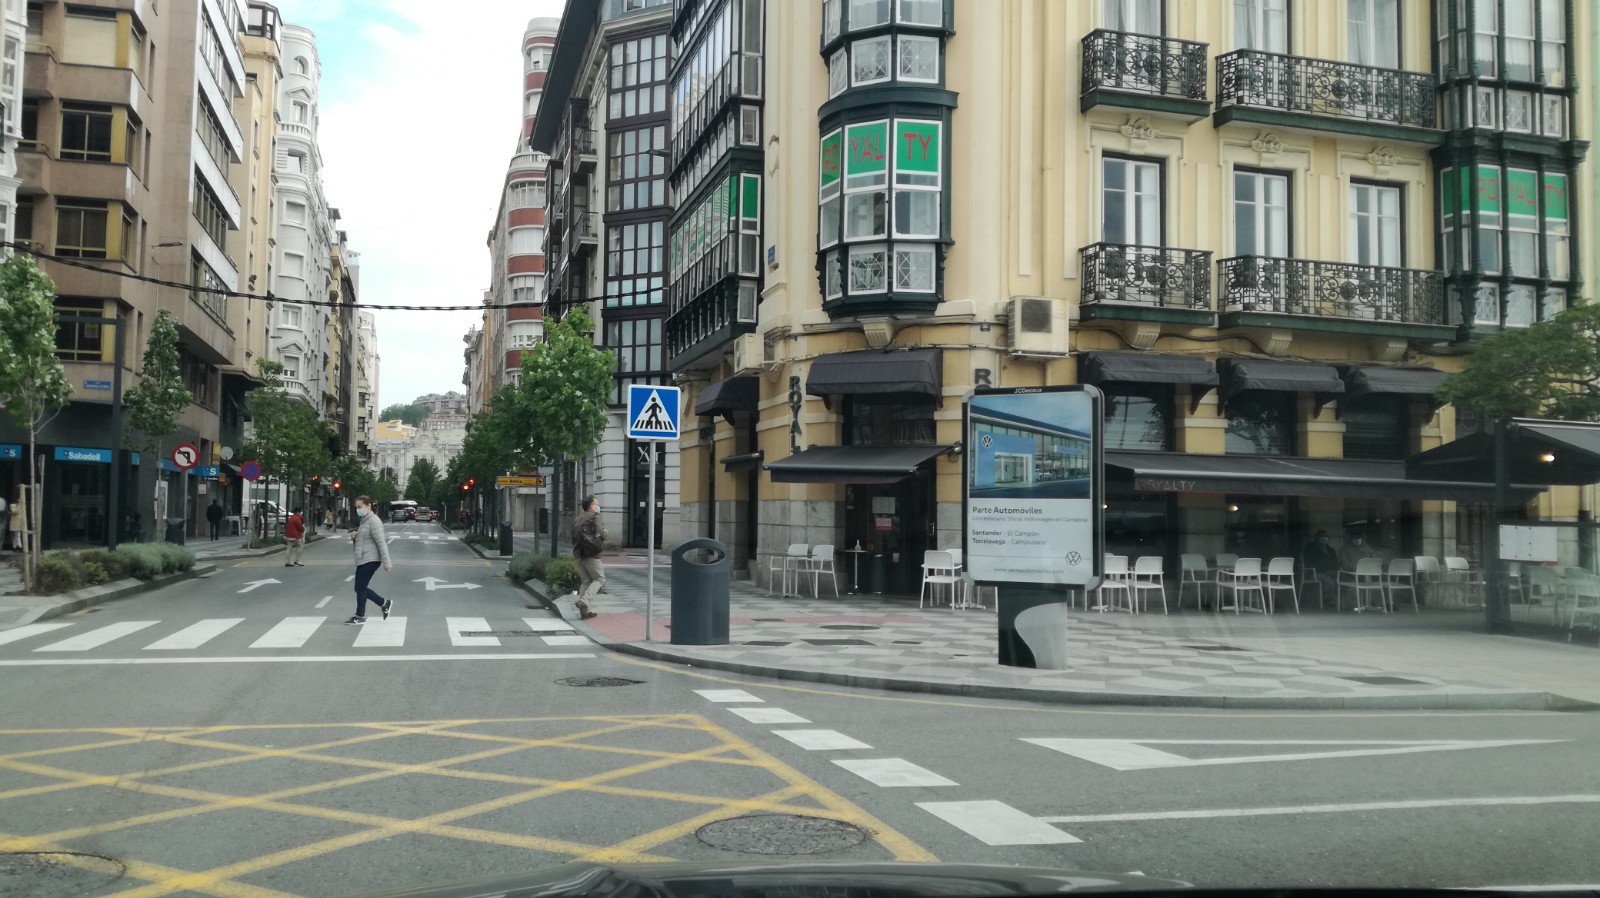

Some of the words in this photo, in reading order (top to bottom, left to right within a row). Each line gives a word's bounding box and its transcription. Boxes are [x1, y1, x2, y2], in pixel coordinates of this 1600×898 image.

[68, 451, 101, 461] Sabadell
[972, 506, 992, 514] Parte
[994, 506, 1043, 514] Automóviles
